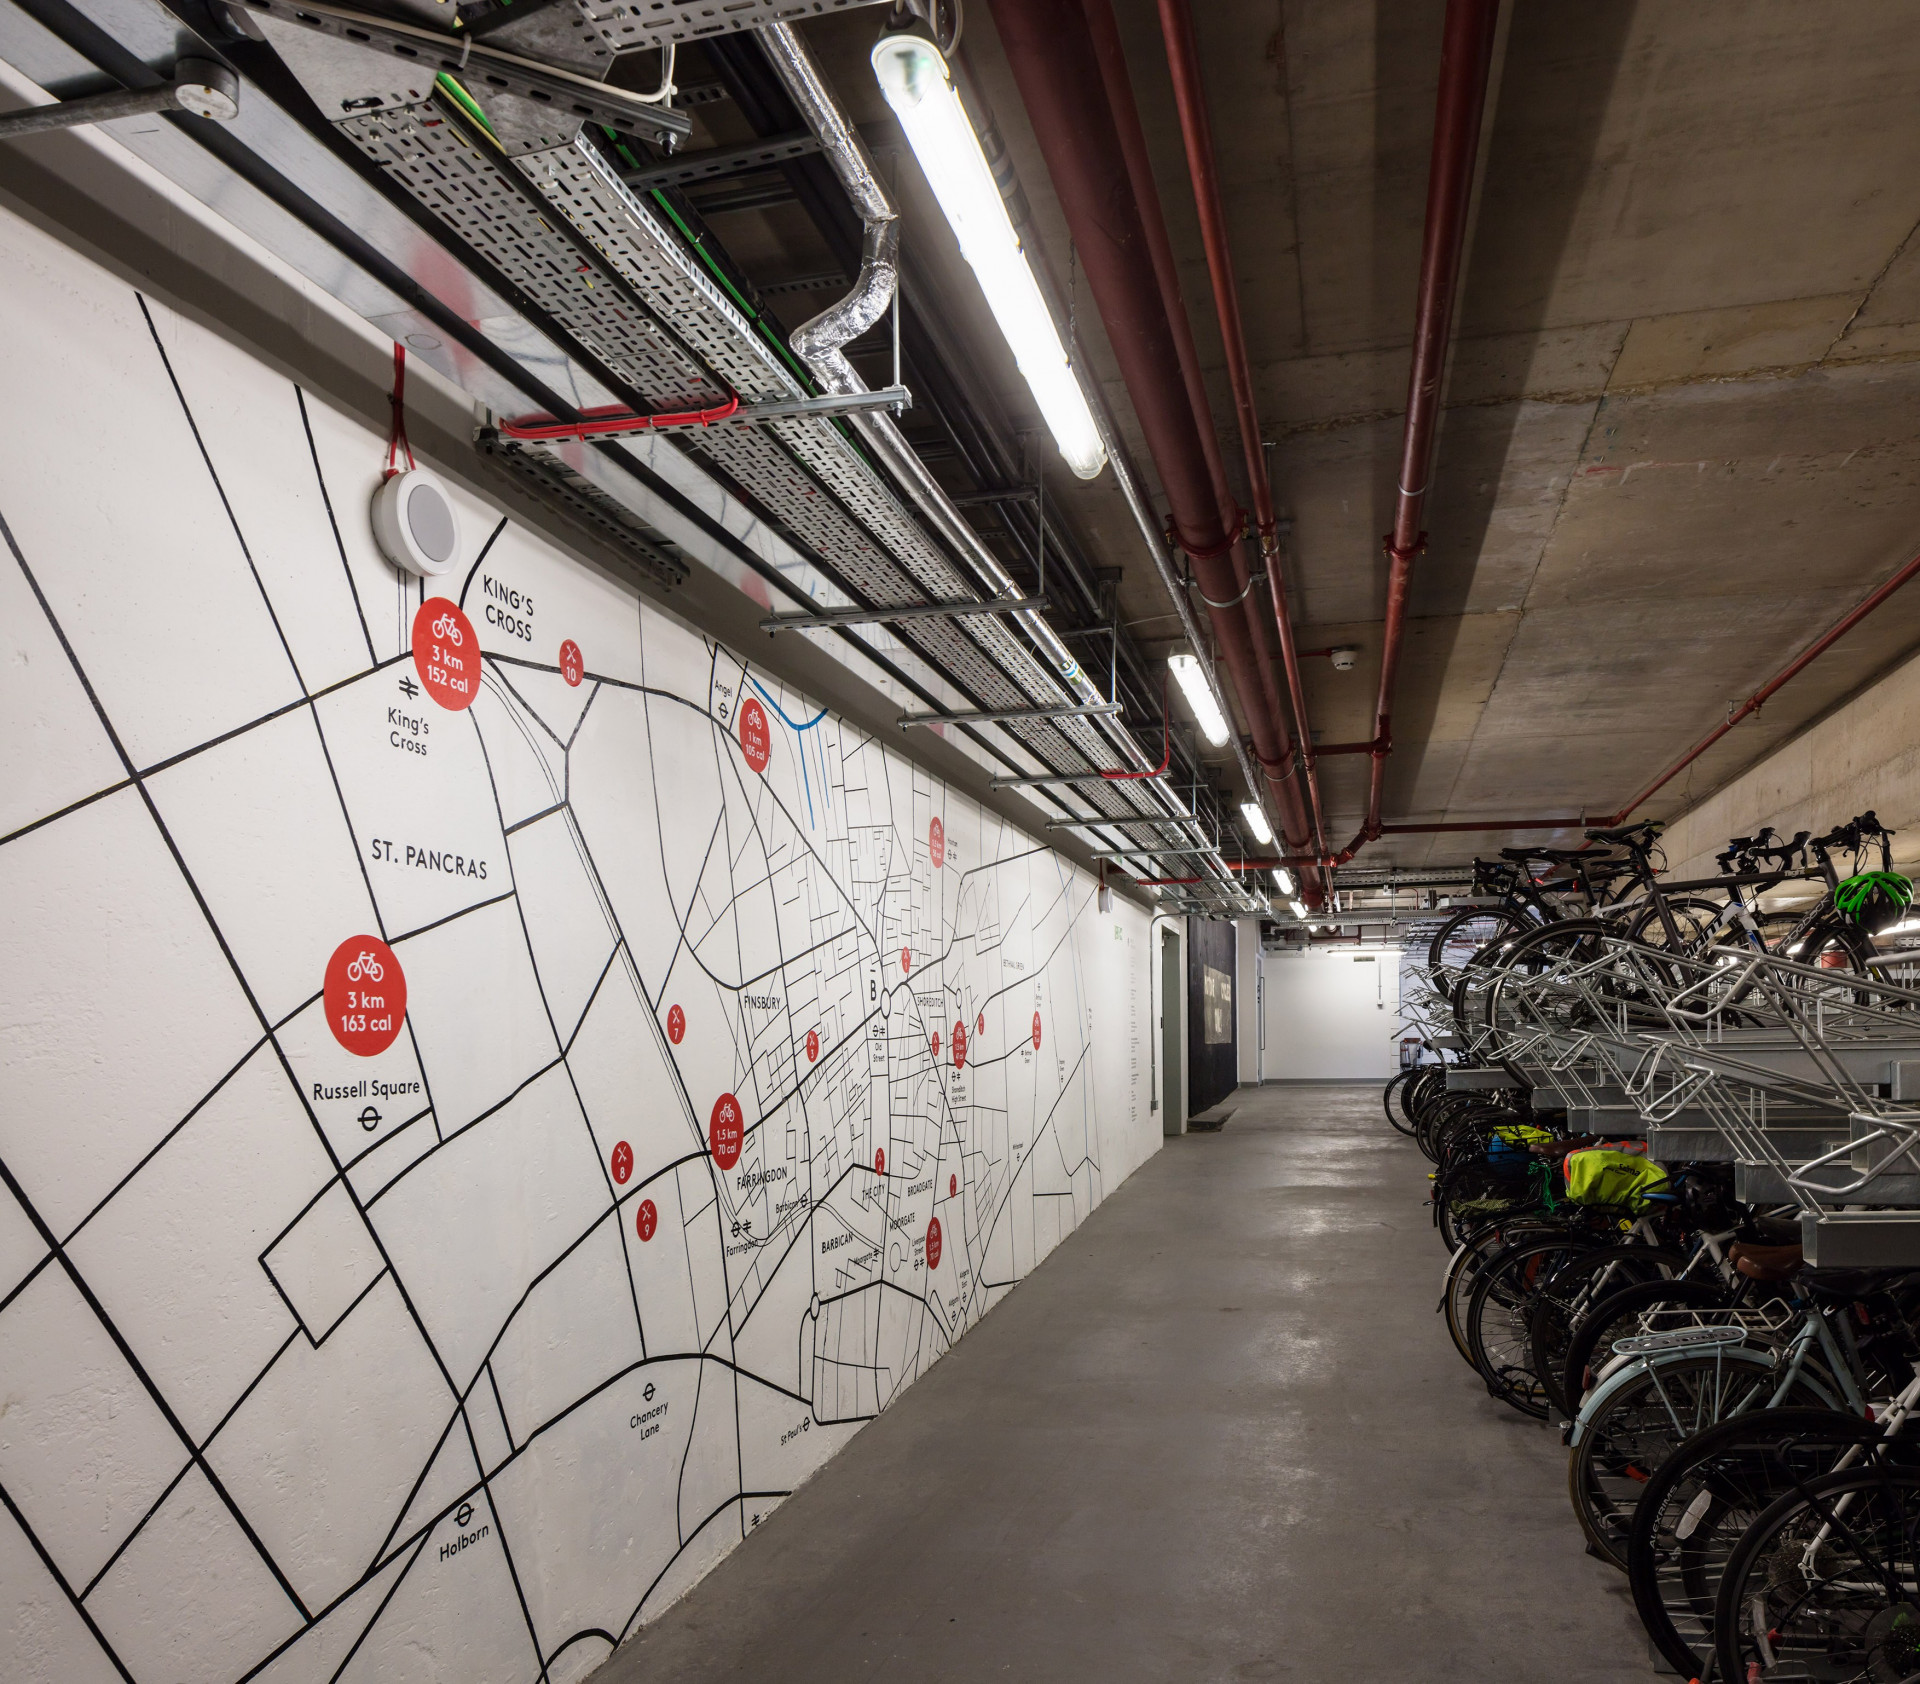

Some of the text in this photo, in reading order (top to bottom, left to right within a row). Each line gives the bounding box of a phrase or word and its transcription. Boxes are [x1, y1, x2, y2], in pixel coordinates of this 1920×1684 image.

[483, 574, 534, 617] KING'S
[485, 605, 532, 642] CROSS
[432, 645, 463, 671] 3 km
[427, 665, 468, 693] 152 cal
[566, 666, 577, 681] 10
[714, 680, 733, 698] Angel
[388, 707, 429, 735] King's
[390, 731, 427, 756] Cross
[752, 732, 762, 746] km
[756, 750, 765, 761] cal
[372, 839, 488, 880] ST. PANCRAS
[870, 980, 876, 1001] B
[348, 992, 384, 1009] 3 km
[744, 995, 780, 1010] FINSBURY
[341, 1014, 392, 1032] 163 cal
[674, 1028, 678, 1039] 7
[312, 1080, 420, 1101] Russell Square
[716, 1129, 738, 1140] 1.5 km
[718, 1144, 736, 1155] 70 cal
[620, 1168, 626, 1179] 8
[737, 1166, 788, 1190] FARRINGDON
[873, 1184, 886, 1197] CITY
[908, 1179, 932, 1196] BROADGATE
[776, 1200, 798, 1214] Barbican
[644, 1225, 650, 1236] 9
[890, 1212, 915, 1232] MOORGATE
[726, 1239, 758, 1258] Farringdon
[822, 1232, 854, 1254] BARBICAN
[630, 1401, 668, 1428] Chancery
[640, 1422, 660, 1441] Lane
[780, 1424, 802, 1446] St Paul's
[1649, 1484, 1678, 1549] ALEXRIMS
[440, 1525, 489, 1562] Holborn
